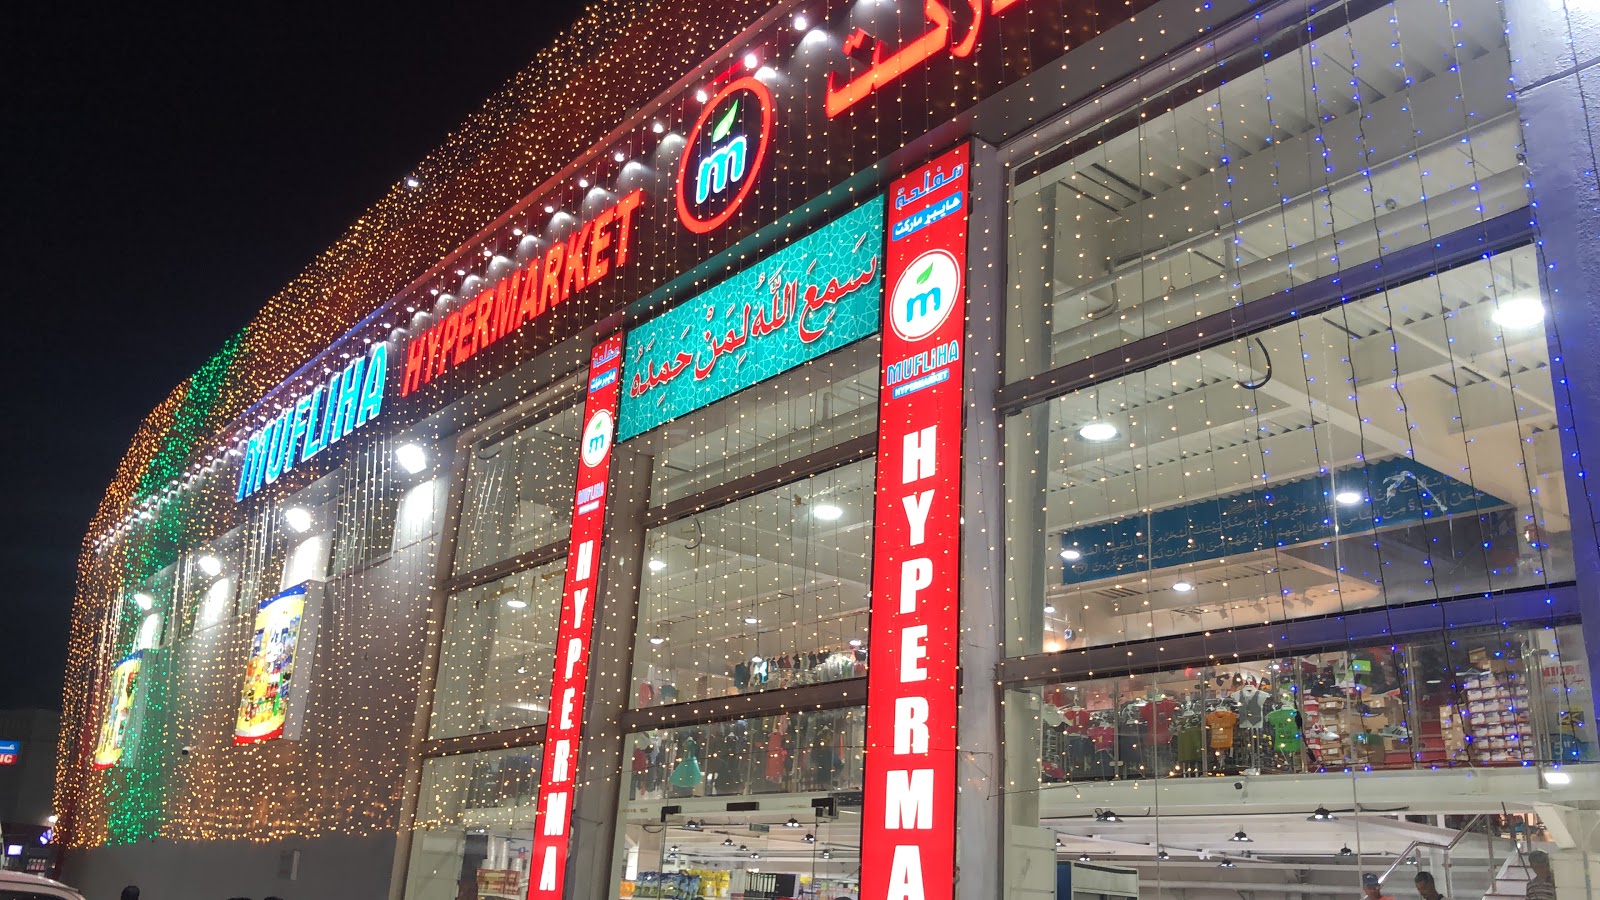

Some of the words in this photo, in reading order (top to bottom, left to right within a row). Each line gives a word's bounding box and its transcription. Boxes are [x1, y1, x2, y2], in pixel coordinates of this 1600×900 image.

[696, 136, 747, 204] m
[895, 163, 964, 210] مفلحة
[895, 216, 923, 236] ماركت
[923, 197, 961, 225] هايبر
[401, 188, 645, 399] HYPERMARKET
[906, 287, 941, 322] m
[236, 341, 388, 503] MUFLIHA
[539, 540, 594, 892] HYPERMA
